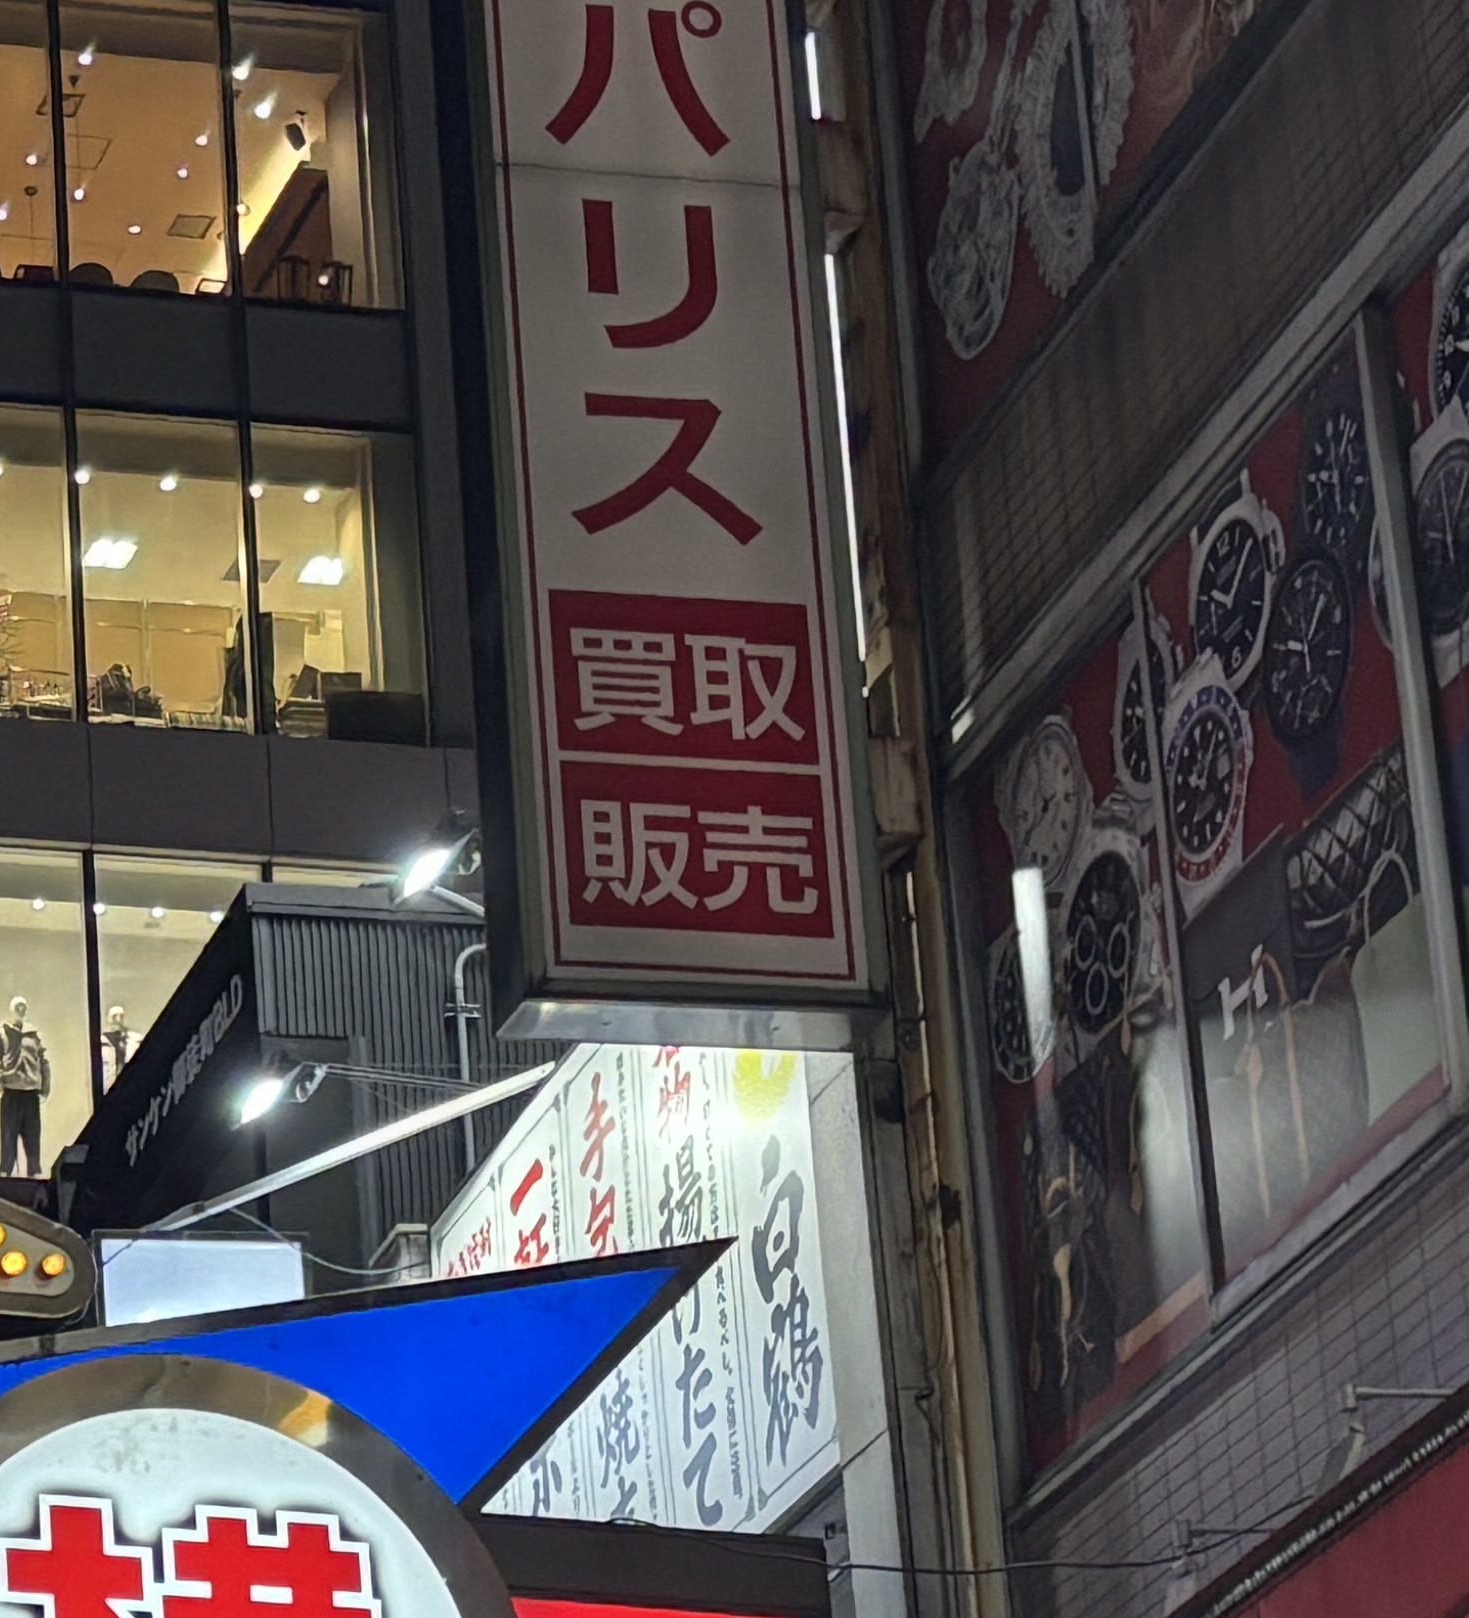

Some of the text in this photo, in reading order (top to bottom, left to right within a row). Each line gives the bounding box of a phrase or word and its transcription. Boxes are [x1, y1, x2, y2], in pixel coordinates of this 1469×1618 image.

[544, 0, 764, 545] パリス
[569, 627, 806, 742] 買取
[581, 800, 819, 916] 販売
